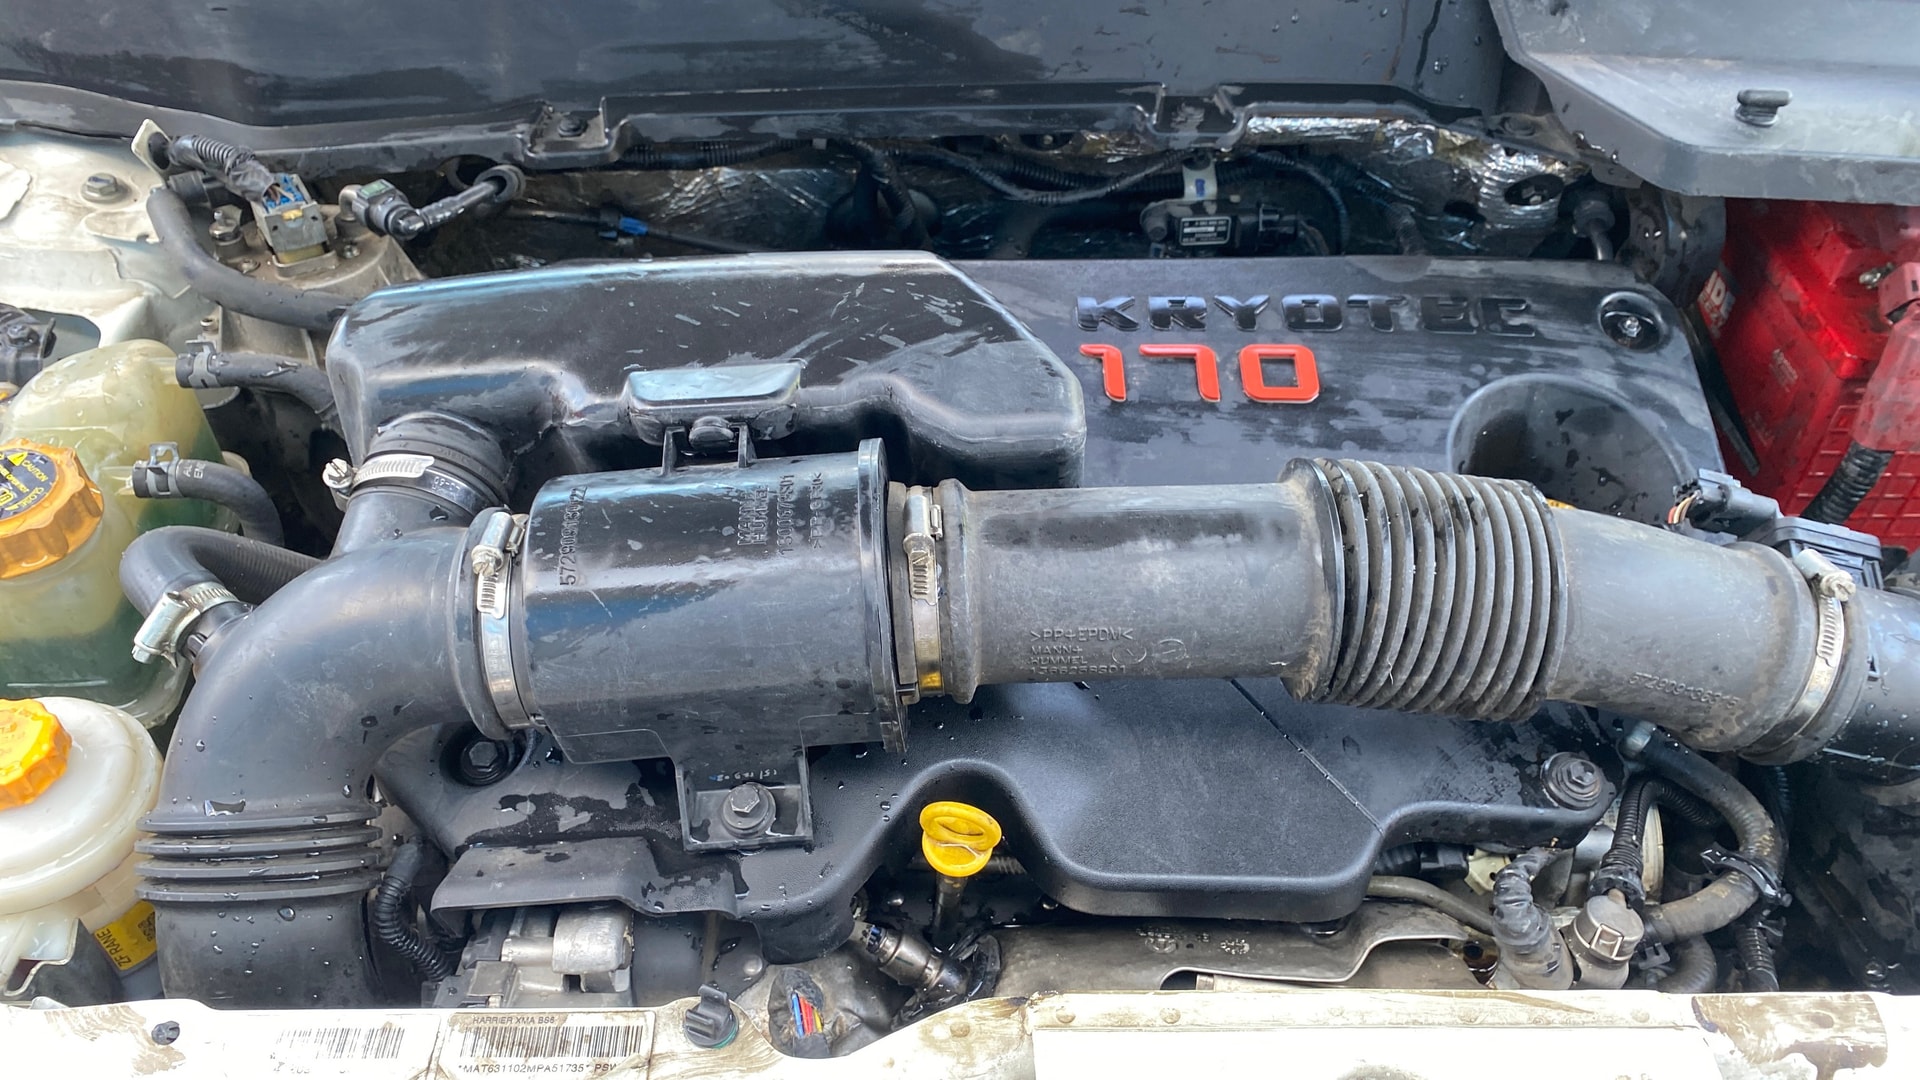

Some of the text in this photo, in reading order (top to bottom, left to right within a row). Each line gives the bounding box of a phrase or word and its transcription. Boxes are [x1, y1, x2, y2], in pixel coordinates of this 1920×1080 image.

[1075, 294, 1536, 337] KRYOTEC
[1079, 343, 1321, 403] 170
[472, 1016, 513, 1025] HARRIER
[538, 1016, 555, 1025] BS6
